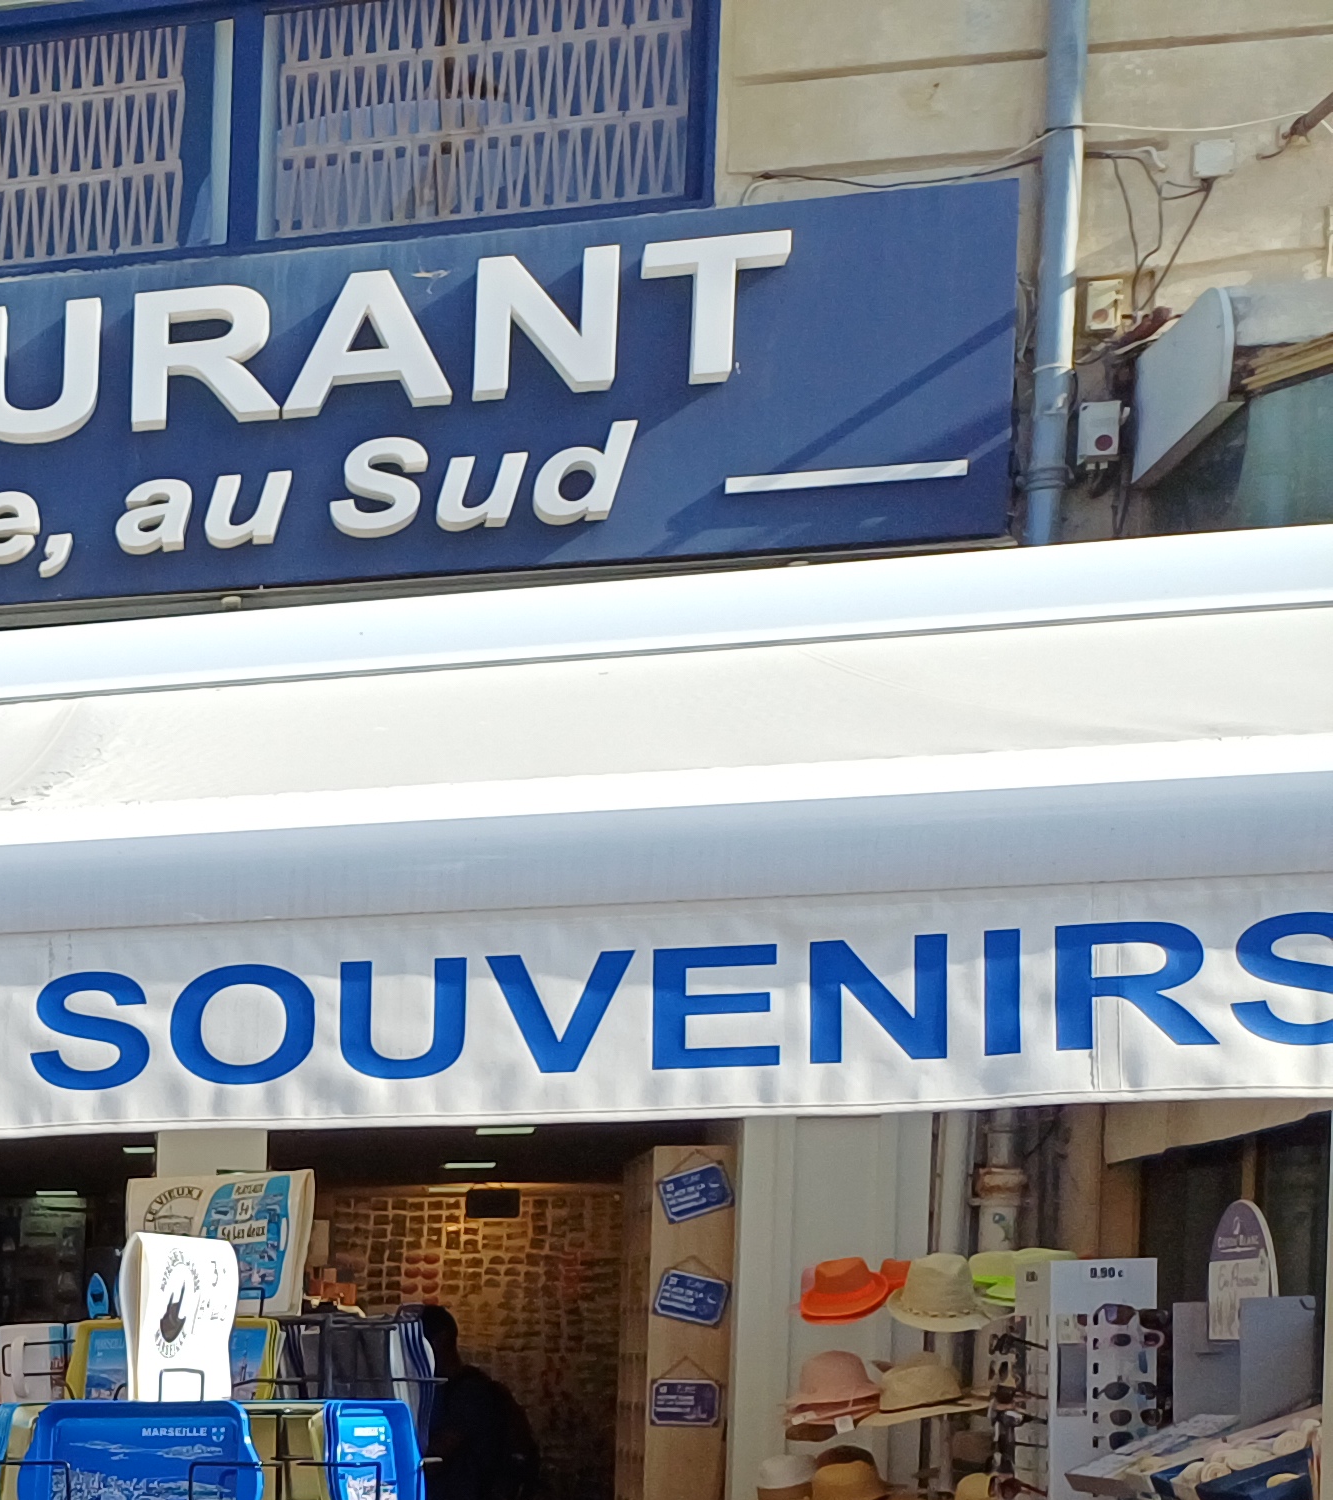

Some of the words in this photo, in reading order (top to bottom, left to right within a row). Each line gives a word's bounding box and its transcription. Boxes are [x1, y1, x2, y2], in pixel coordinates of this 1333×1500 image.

[115, 470, 292, 556] au
[330, 420, 638, 538] Sud
[29, 910, 1333, 1091] SOUVENIRS
[155, 1187, 193, 1206] VIEUX
[142, 1426, 208, 1438] MARSEILLE
